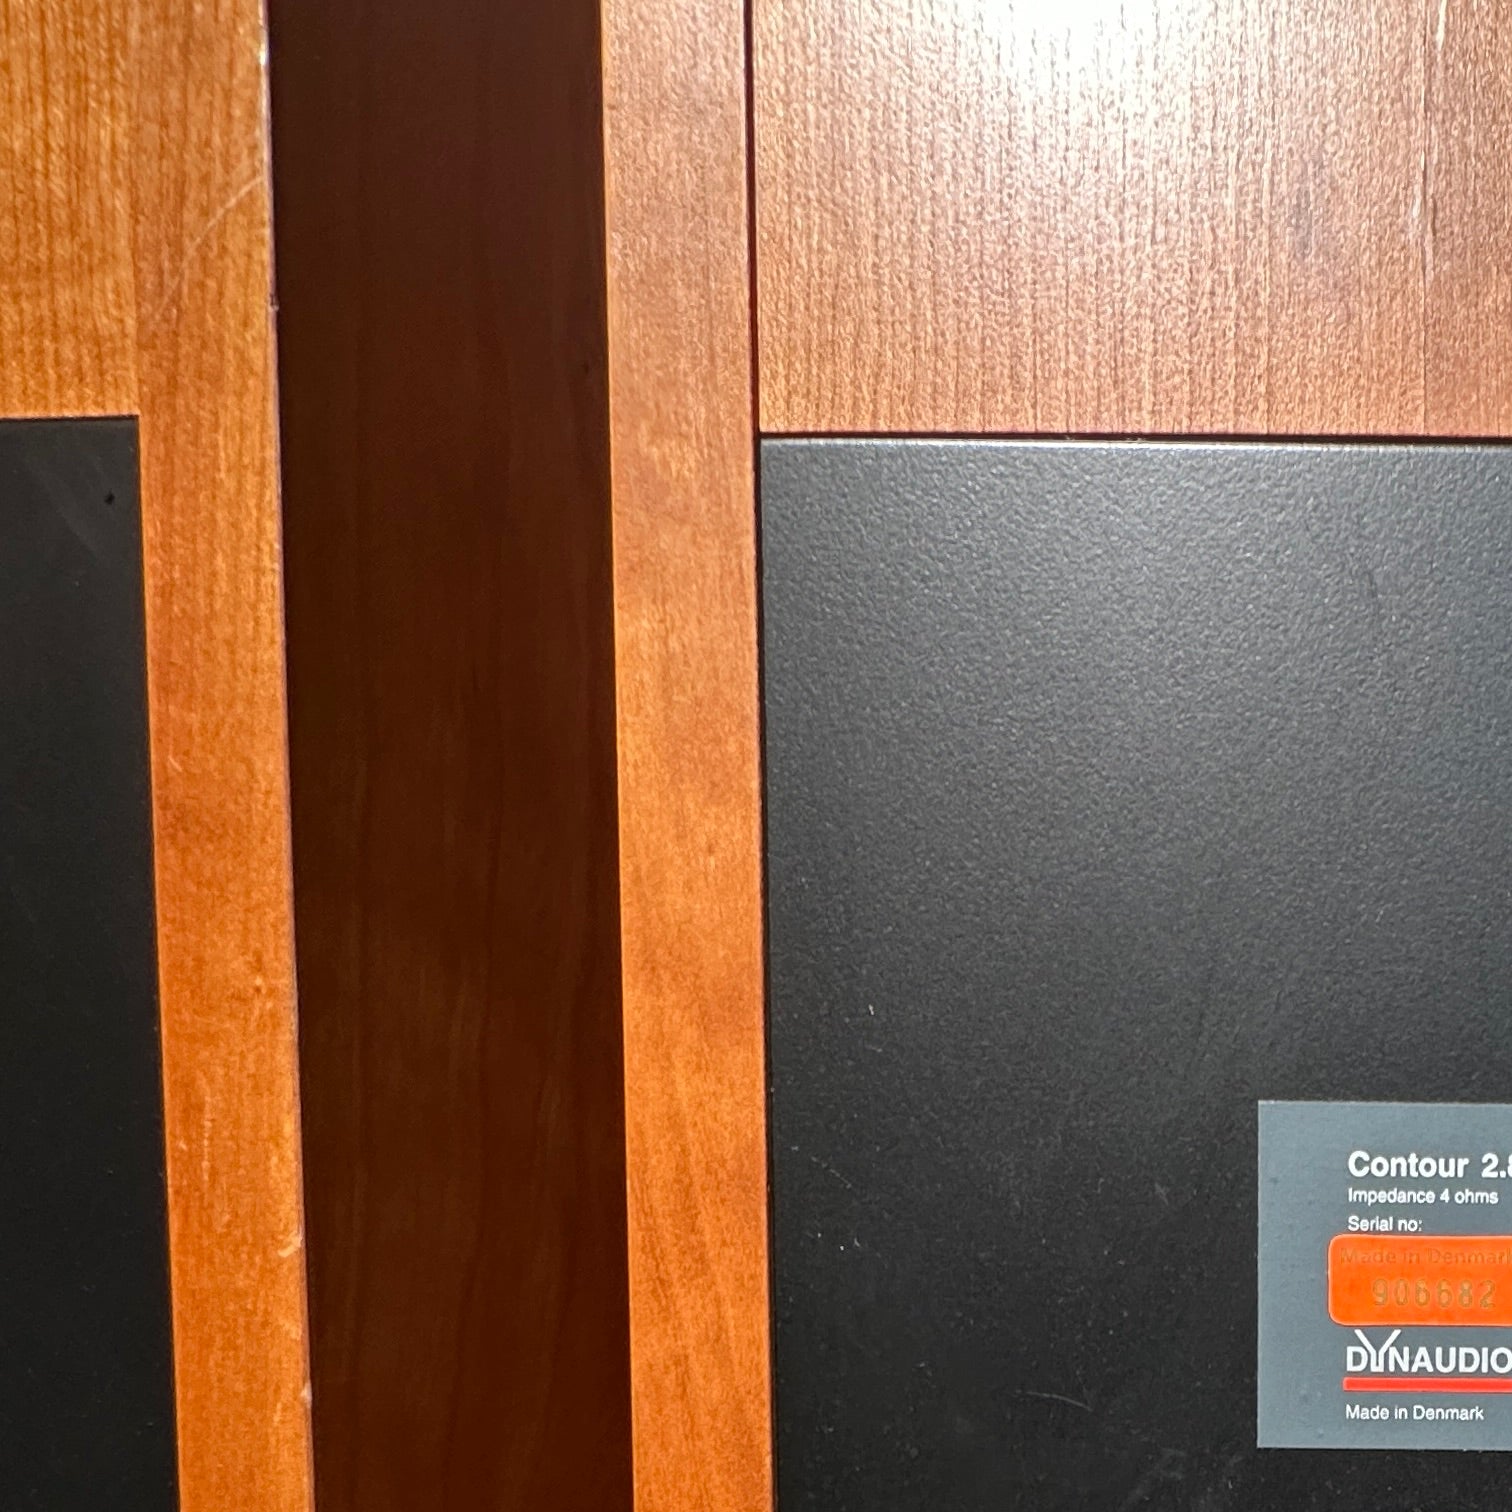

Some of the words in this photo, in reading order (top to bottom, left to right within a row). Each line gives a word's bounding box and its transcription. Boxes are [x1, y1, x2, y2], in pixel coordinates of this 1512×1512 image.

[1348, 1150, 1470, 1178] Contour
[1348, 1187, 1435, 1206] Impedance
[1439, 1188, 1450, 1203] 4
[1454, 1189, 1499, 1205] ohms
[1347, 1215, 1393, 1232] Serial
[1397, 1218, 1423, 1232] no:
[1340, 1248, 1396, 1265] Made
[1403, 1248, 1421, 1265] in
[1372, 1278, 1496, 1309] 906682
[1345, 1404, 1390, 1420] Made
[1394, 1405, 1409, 1420] in
[1412, 1404, 1485, 1421] Denmark
